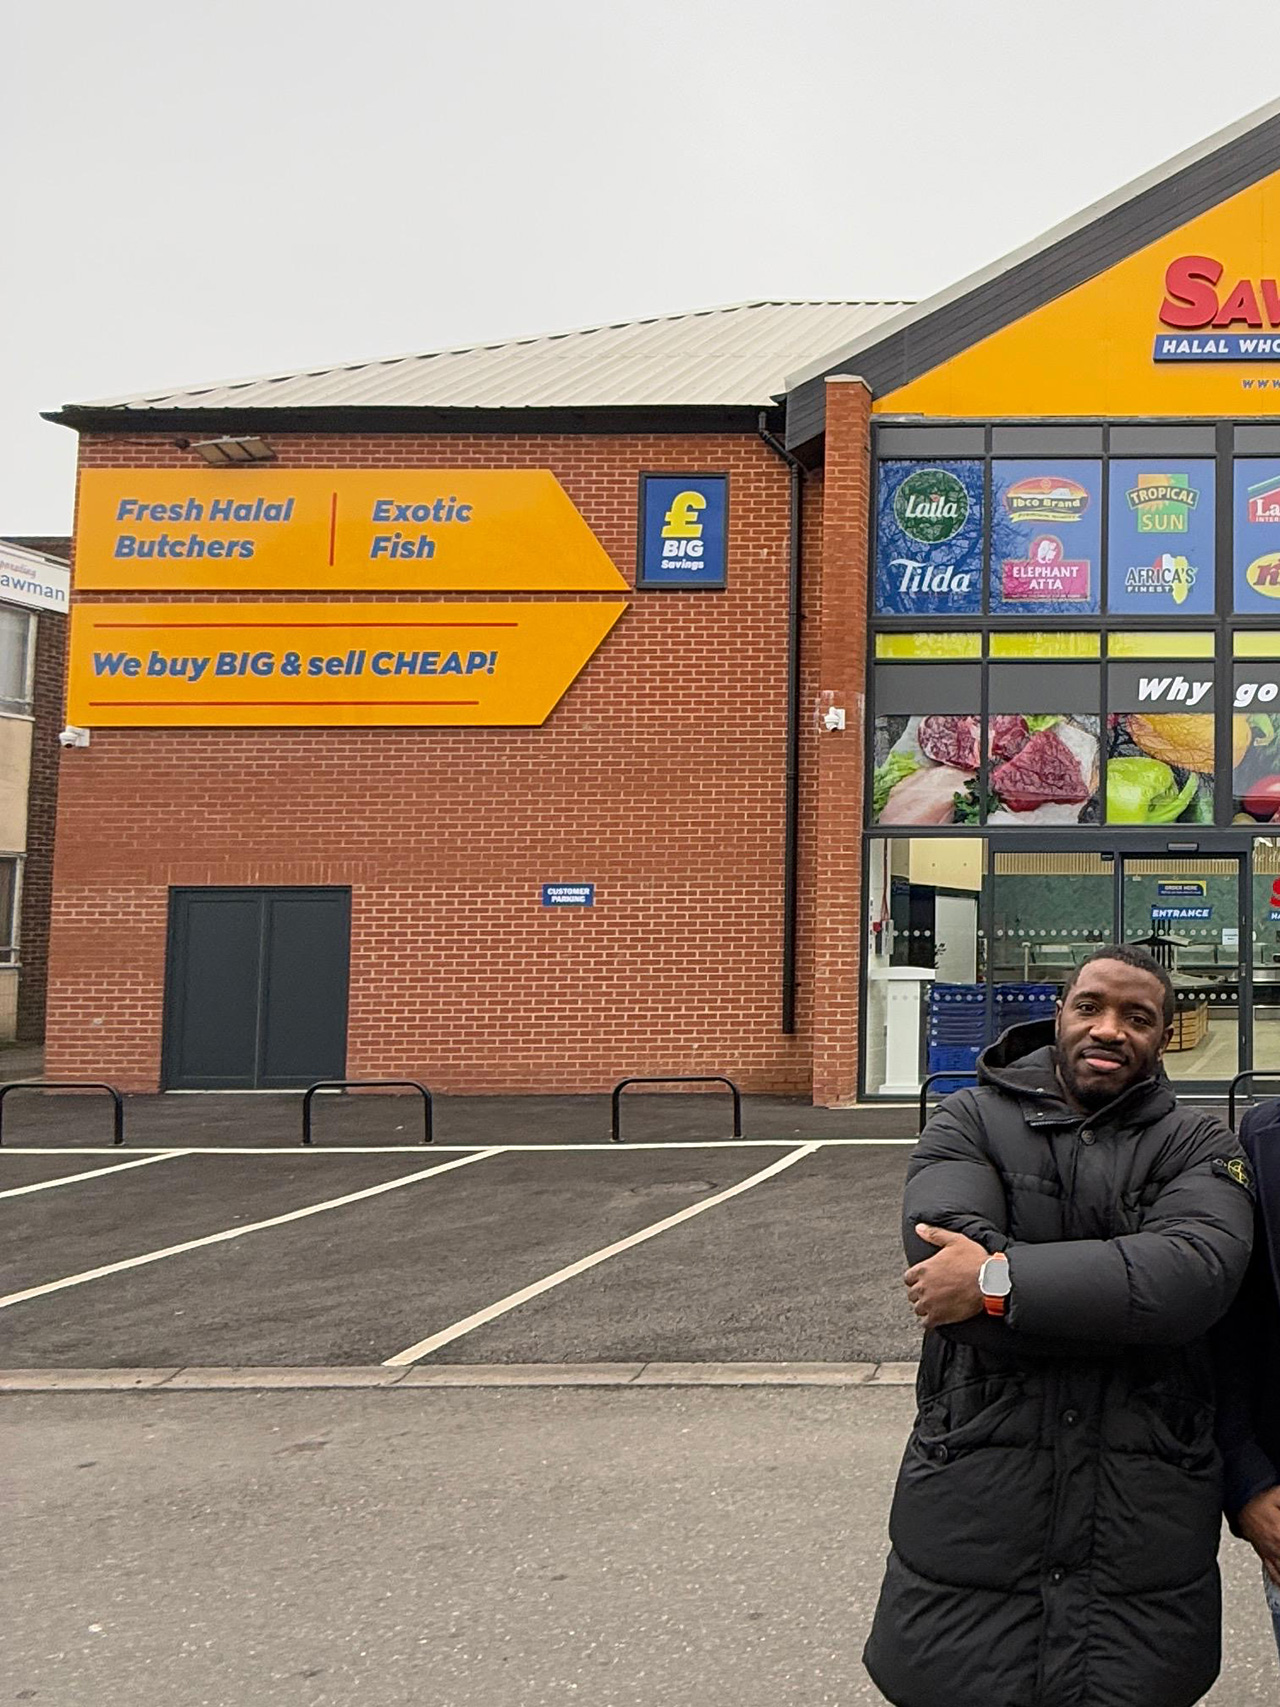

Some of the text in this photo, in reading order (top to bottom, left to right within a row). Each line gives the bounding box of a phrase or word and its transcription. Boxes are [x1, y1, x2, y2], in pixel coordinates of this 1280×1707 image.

[1161, 338, 1229, 354] HALAL
[1013, 499, 1081, 507] Ibco Brand
[1130, 487, 1195, 505] TROPICAL
[115, 497, 294, 523] Fresh Halal
[371, 496, 473, 524] Exotic
[905, 495, 958, 518] Laila
[1142, 514, 1184, 531] SUN
[113, 534, 255, 560] Butchers
[369, 534, 436, 560] Fish
[661, 539, 704, 557] BIG
[661, 559, 704, 570] Savings
[1012, 566, 1079, 578] ELEPHANT
[888, 558, 972, 592] Tilda
[1029, 578, 1063, 590] ATTA
[1126, 567, 1196, 585] AFRICA'S
[92, 650, 497, 682] We buy BIG & sell CHEAP!
[1138, 677, 1213, 706] Why
[1234, 680, 1279, 707] go
[1152, 909, 1210, 917] ENTRANCE
